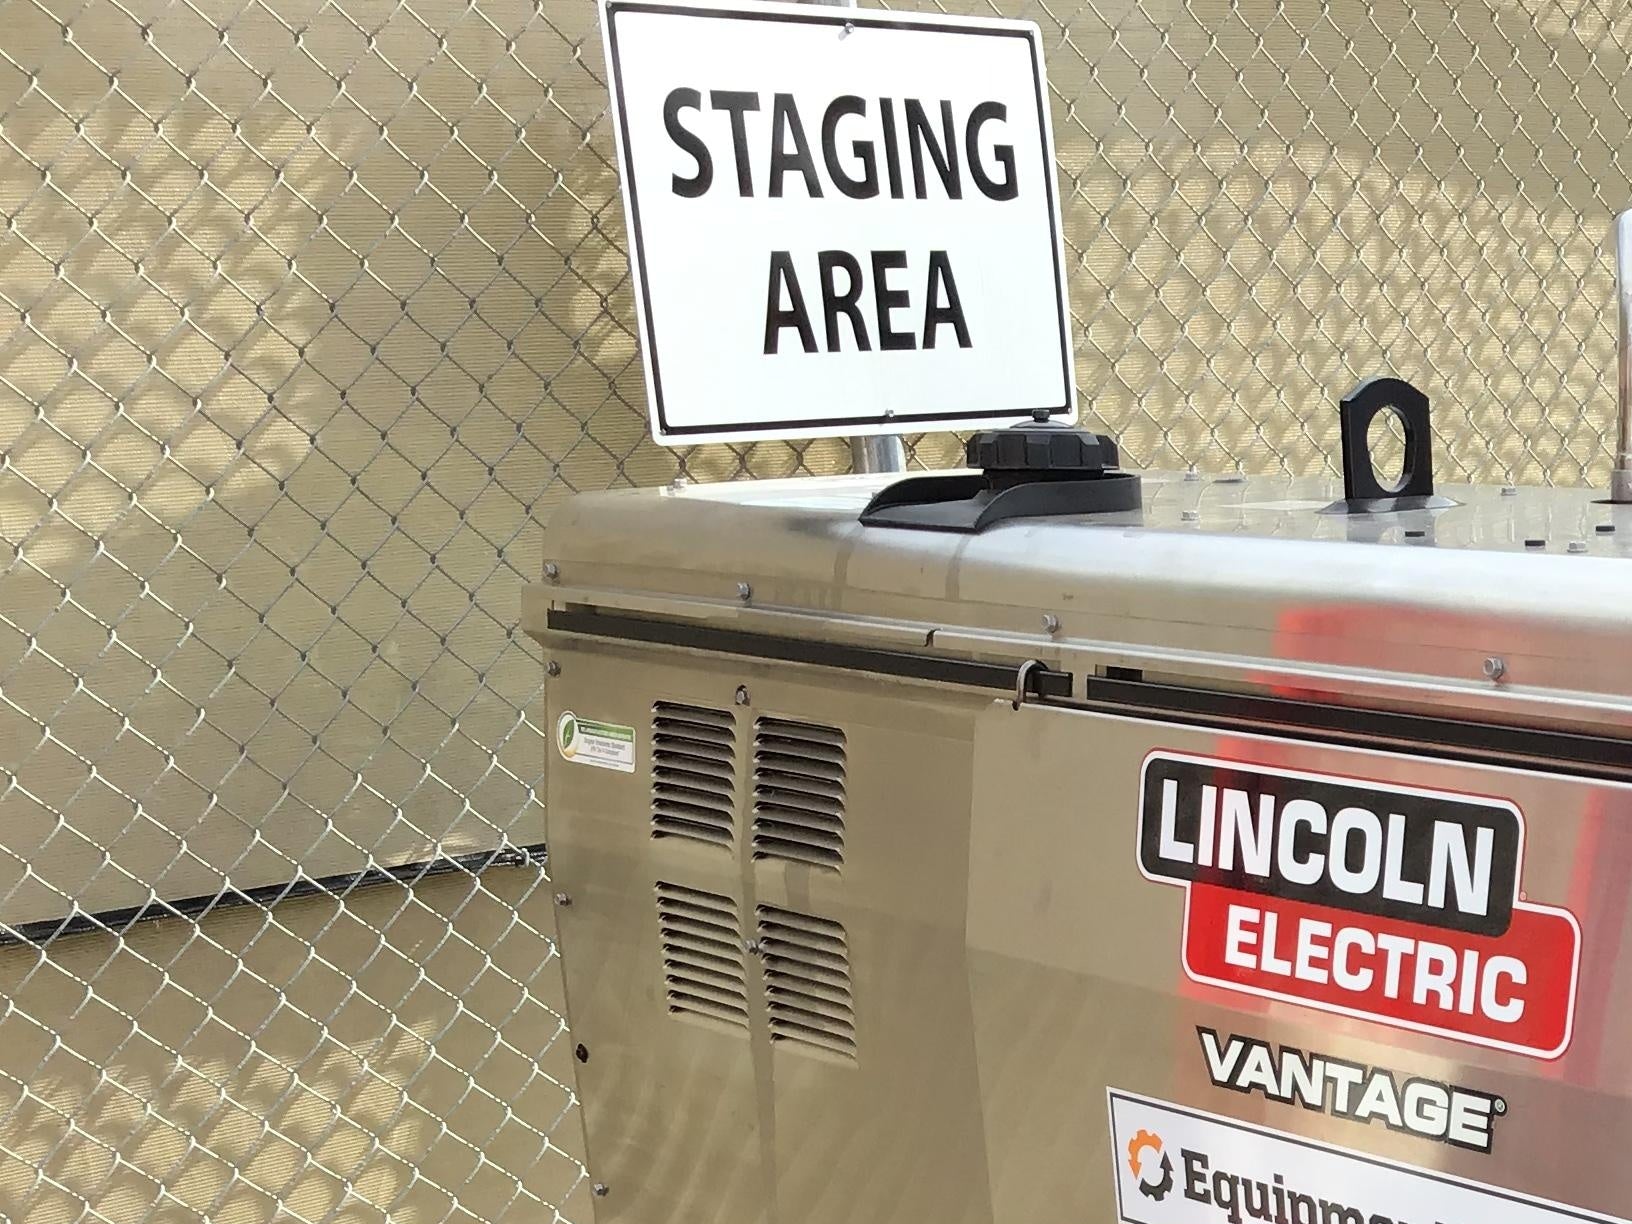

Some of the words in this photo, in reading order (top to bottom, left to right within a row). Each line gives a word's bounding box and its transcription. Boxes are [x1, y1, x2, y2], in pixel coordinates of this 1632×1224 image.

[663, 87, 1018, 201] STAGING
[764, 251, 972, 354] AREA
[1159, 779, 1495, 916] LINCOLN
[1225, 904, 1528, 1024] ELECTRIC
[1200, 1030, 1492, 1149] VANTAGE
